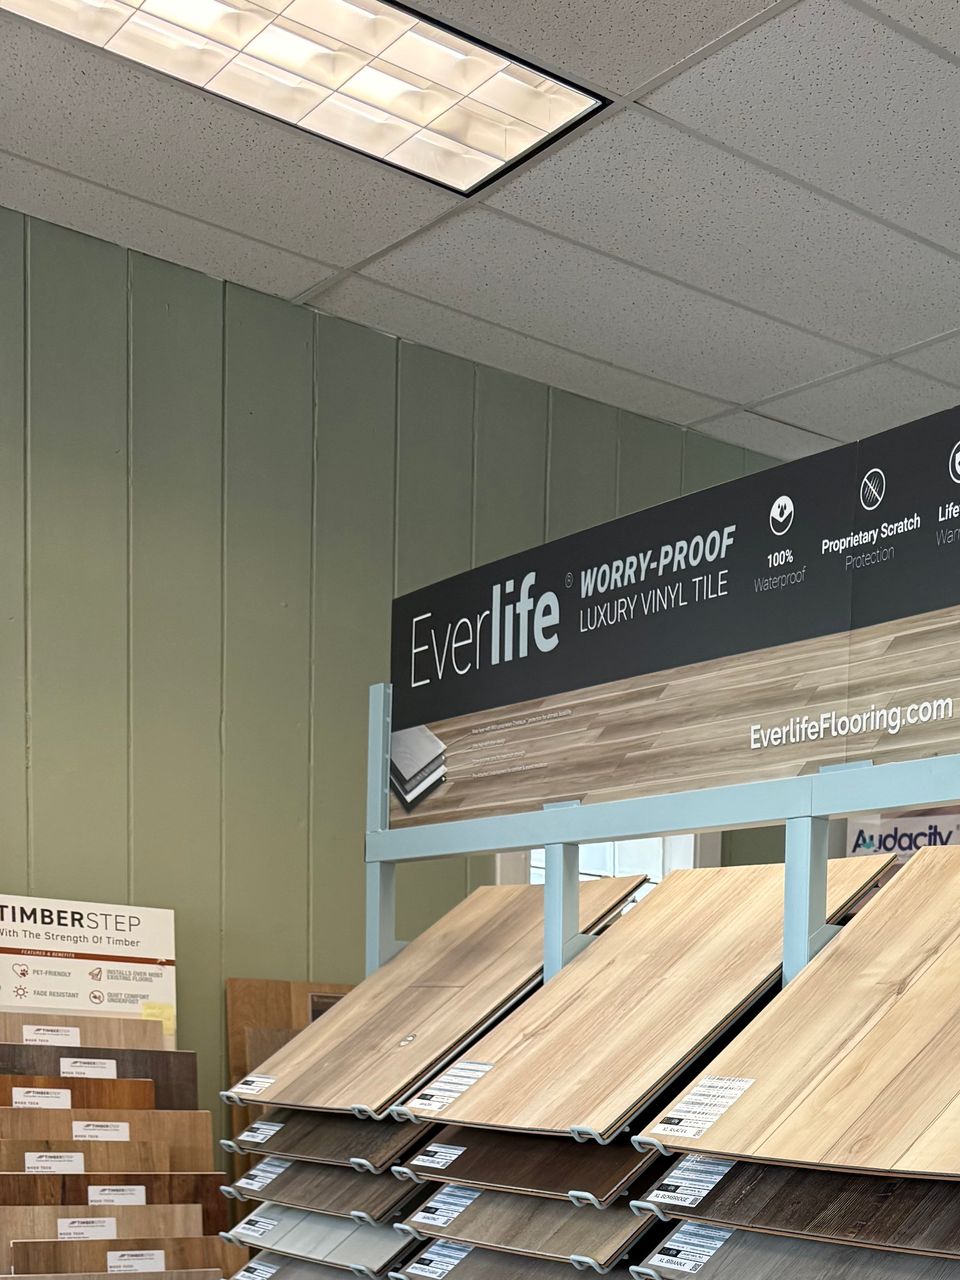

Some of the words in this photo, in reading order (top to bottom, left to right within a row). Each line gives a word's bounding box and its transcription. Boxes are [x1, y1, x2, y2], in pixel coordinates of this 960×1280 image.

[821, 526, 879, 554] Proprietary
[880, 513, 921, 538] Scratch
[580, 524, 737, 599] WORRY-PROOF
[767, 549, 794, 568] 100%
[845, 545, 895, 571] Protection
[753, 566, 807, 592] Waterproof
[580, 594, 638, 632] LUXURY
[640, 582, 688, 616] VINYL
[692, 570, 728, 602] TILE
[411, 571, 560, 688] Everlife
[750, 697, 953, 750] EverlifeFlooring.com
[851, 824, 954, 853] Audacity
[0, 904, 141, 933] TIMBERSTEP
[22, 930, 41, 940] The
[44, 932, 89, 944] Strength
[92, 936, 103, 944] Of
[106, 937, 141, 948] Timber
[32, 969, 72, 978] PET-FRIENDLY
[107, 974, 131, 982] EXISTING
[48, 990, 79, 998] RESISTANT
[107, 992, 122, 1000] QUIET
